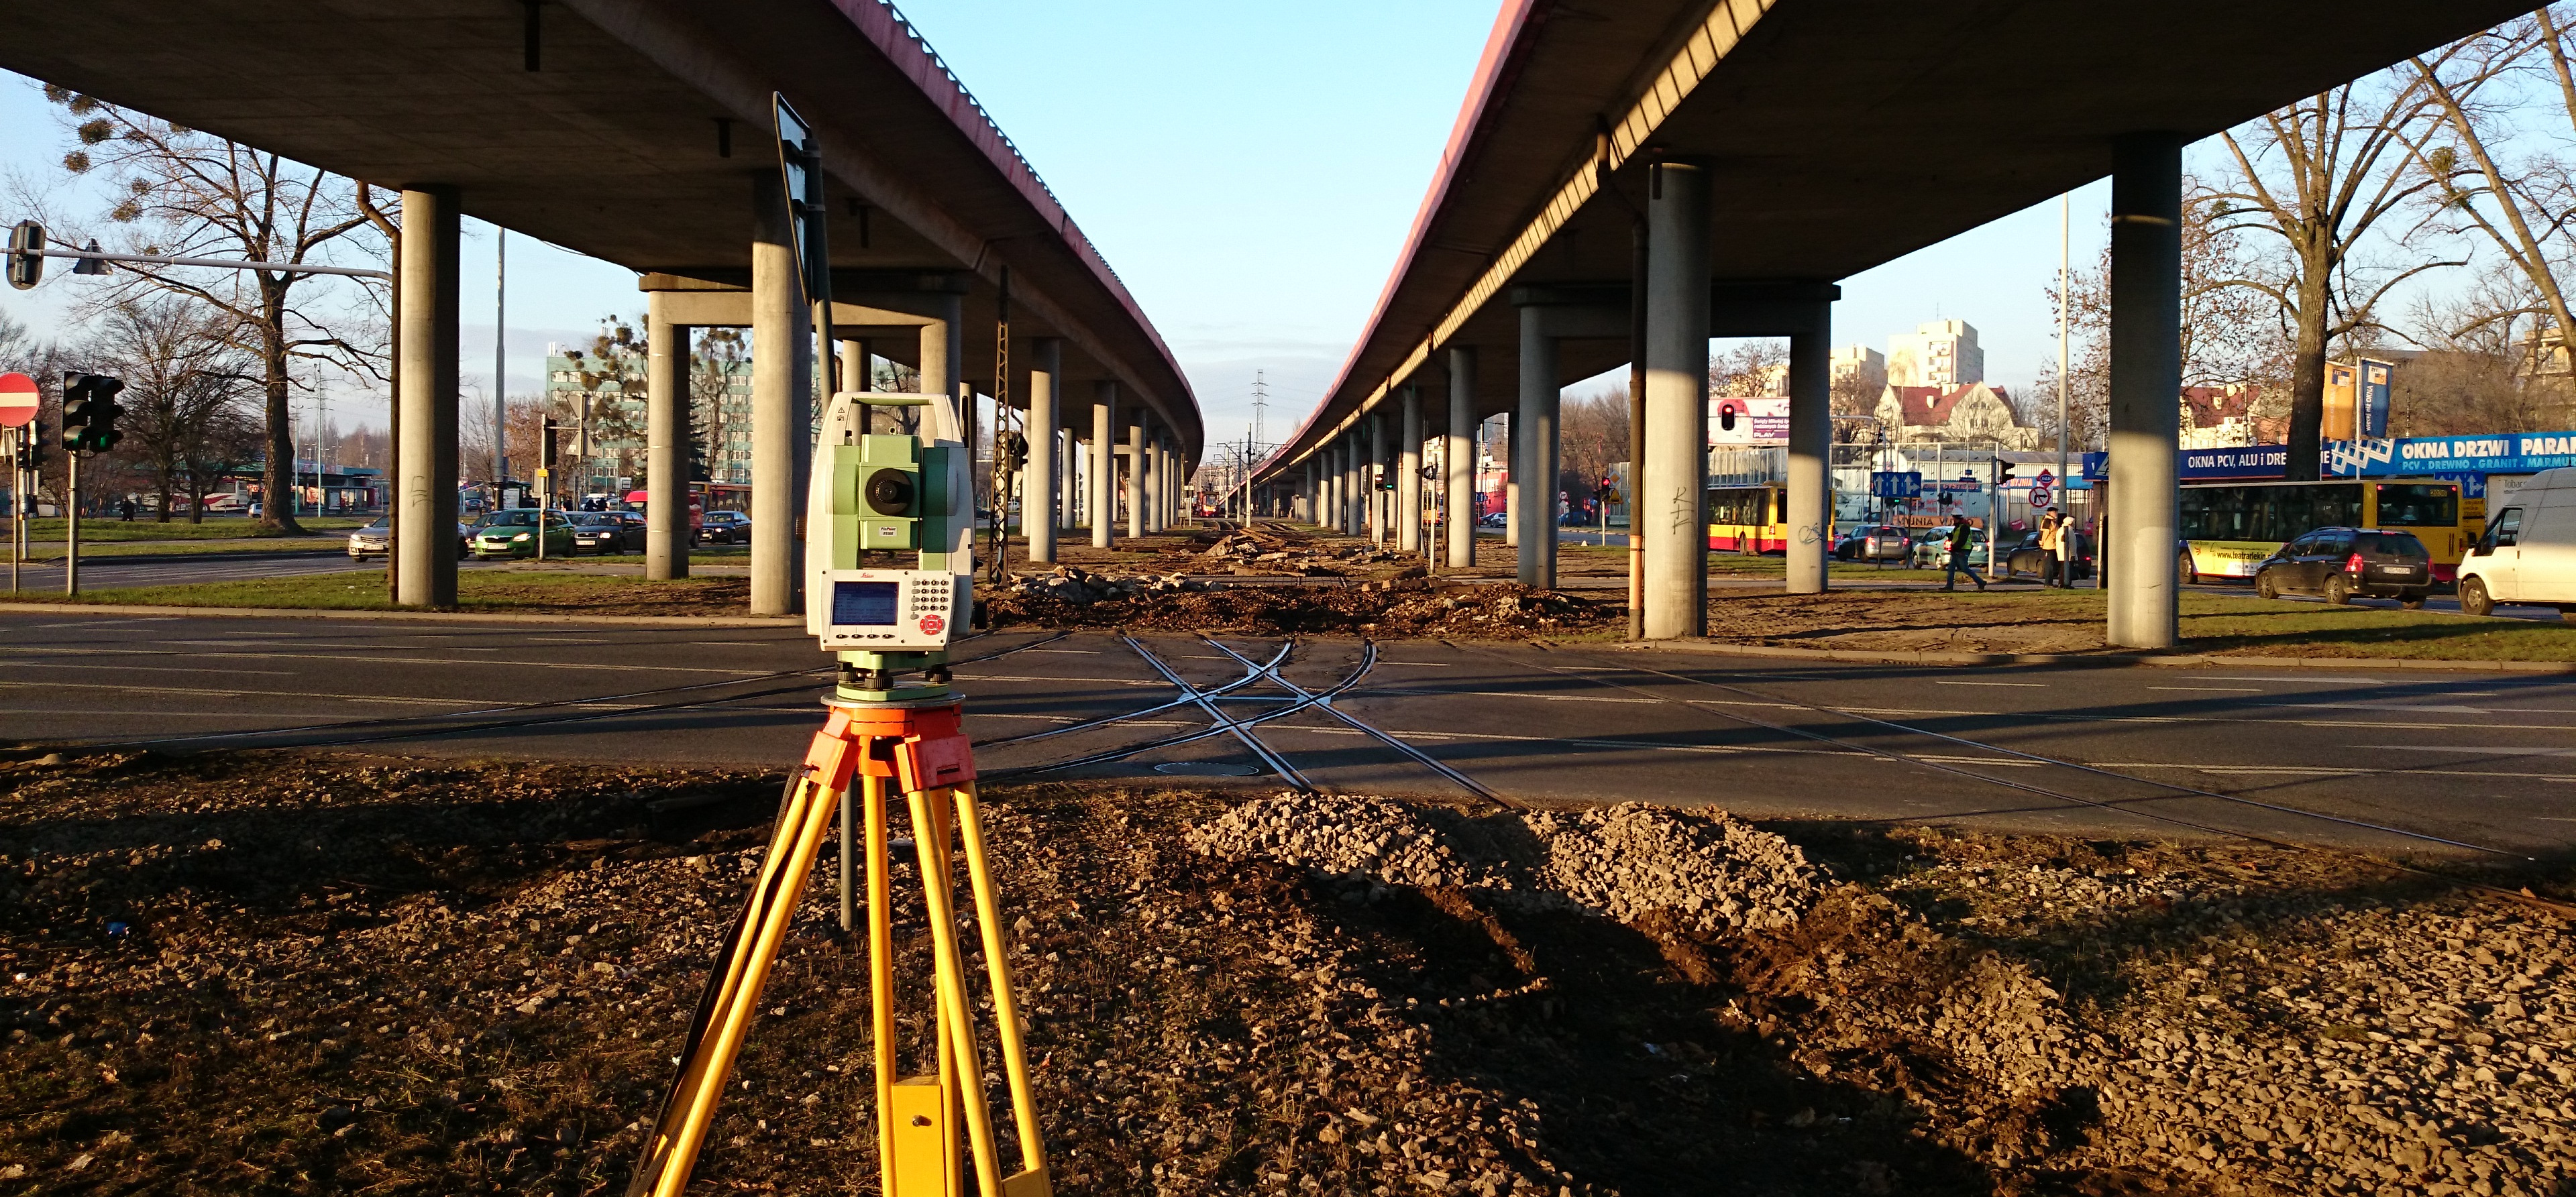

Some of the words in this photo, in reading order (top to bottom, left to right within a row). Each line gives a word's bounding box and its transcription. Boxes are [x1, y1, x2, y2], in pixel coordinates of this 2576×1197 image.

[2365, 386, 2373, 402] OKNA
[2402, 442, 2449, 459] OKNA
[2454, 440, 2510, 458] DRZWI
[2188, 455, 2215, 468] OKNA
[2217, 455, 2236, 468] PCV,
[2239, 453, 2257, 466] ALU
[2260, 453, 2264, 465] i
[2402, 461, 2421, 470] PCV
[2428, 459, 2470, 469] DREWNO
[2477, 458, 2518, 469] GRANIT
[2526, 456, 2576, 467] MARMUR
[2010, 477, 2033, 487] MYJNIA
